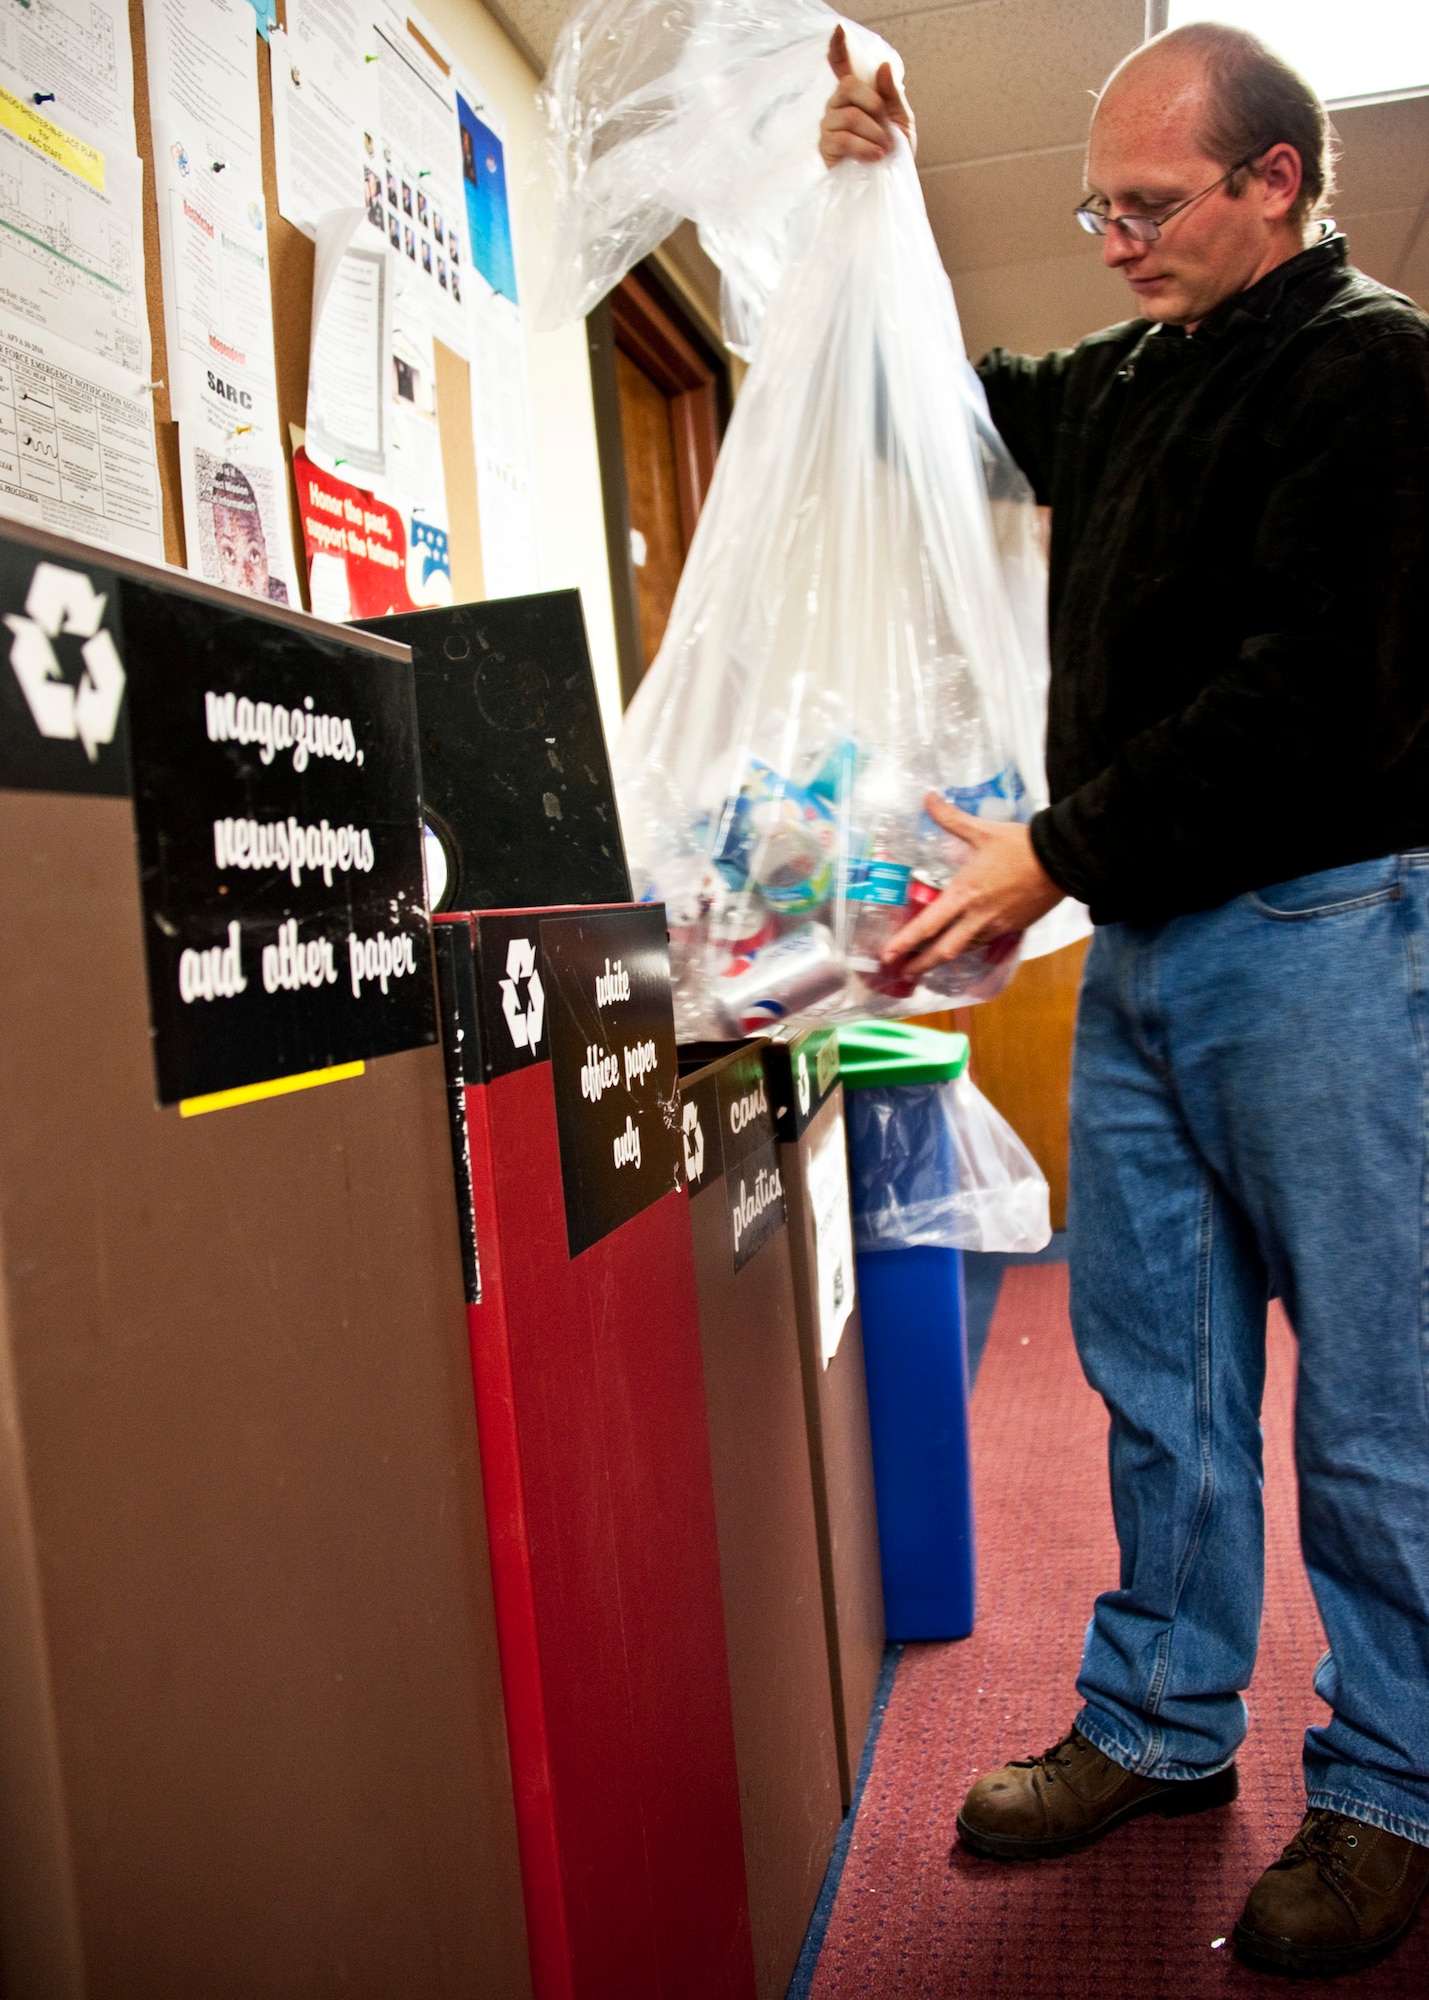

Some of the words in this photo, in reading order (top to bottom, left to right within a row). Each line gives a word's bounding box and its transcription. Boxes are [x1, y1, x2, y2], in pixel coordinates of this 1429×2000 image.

[5, 346, 30, 365] FORCE
[31, 358, 74, 385] EMERGENCY
[75, 377, 123, 405] NOTIFICATION
[207, 370, 252, 410] SARC
[306, 516, 348, 550] support
[347, 530, 367, 558] the
[309, 481, 343, 517] Honor
[343, 498, 363, 527] the
[363, 511, 392, 541] past,
[205, 690, 364, 773] magazines,
[213, 816, 375, 888] newspapers
[179, 920, 247, 1004] and
[262, 918, 338, 994] other
[349, 931, 416, 999] paper
[595, 957, 631, 1008] white
[581, 1043, 620, 1102] office
[623, 1039, 658, 1092] paper
[729, 1078, 768, 1134] cans
[613, 1115, 642, 1169] only
[732, 1168, 783, 1252] plastics
